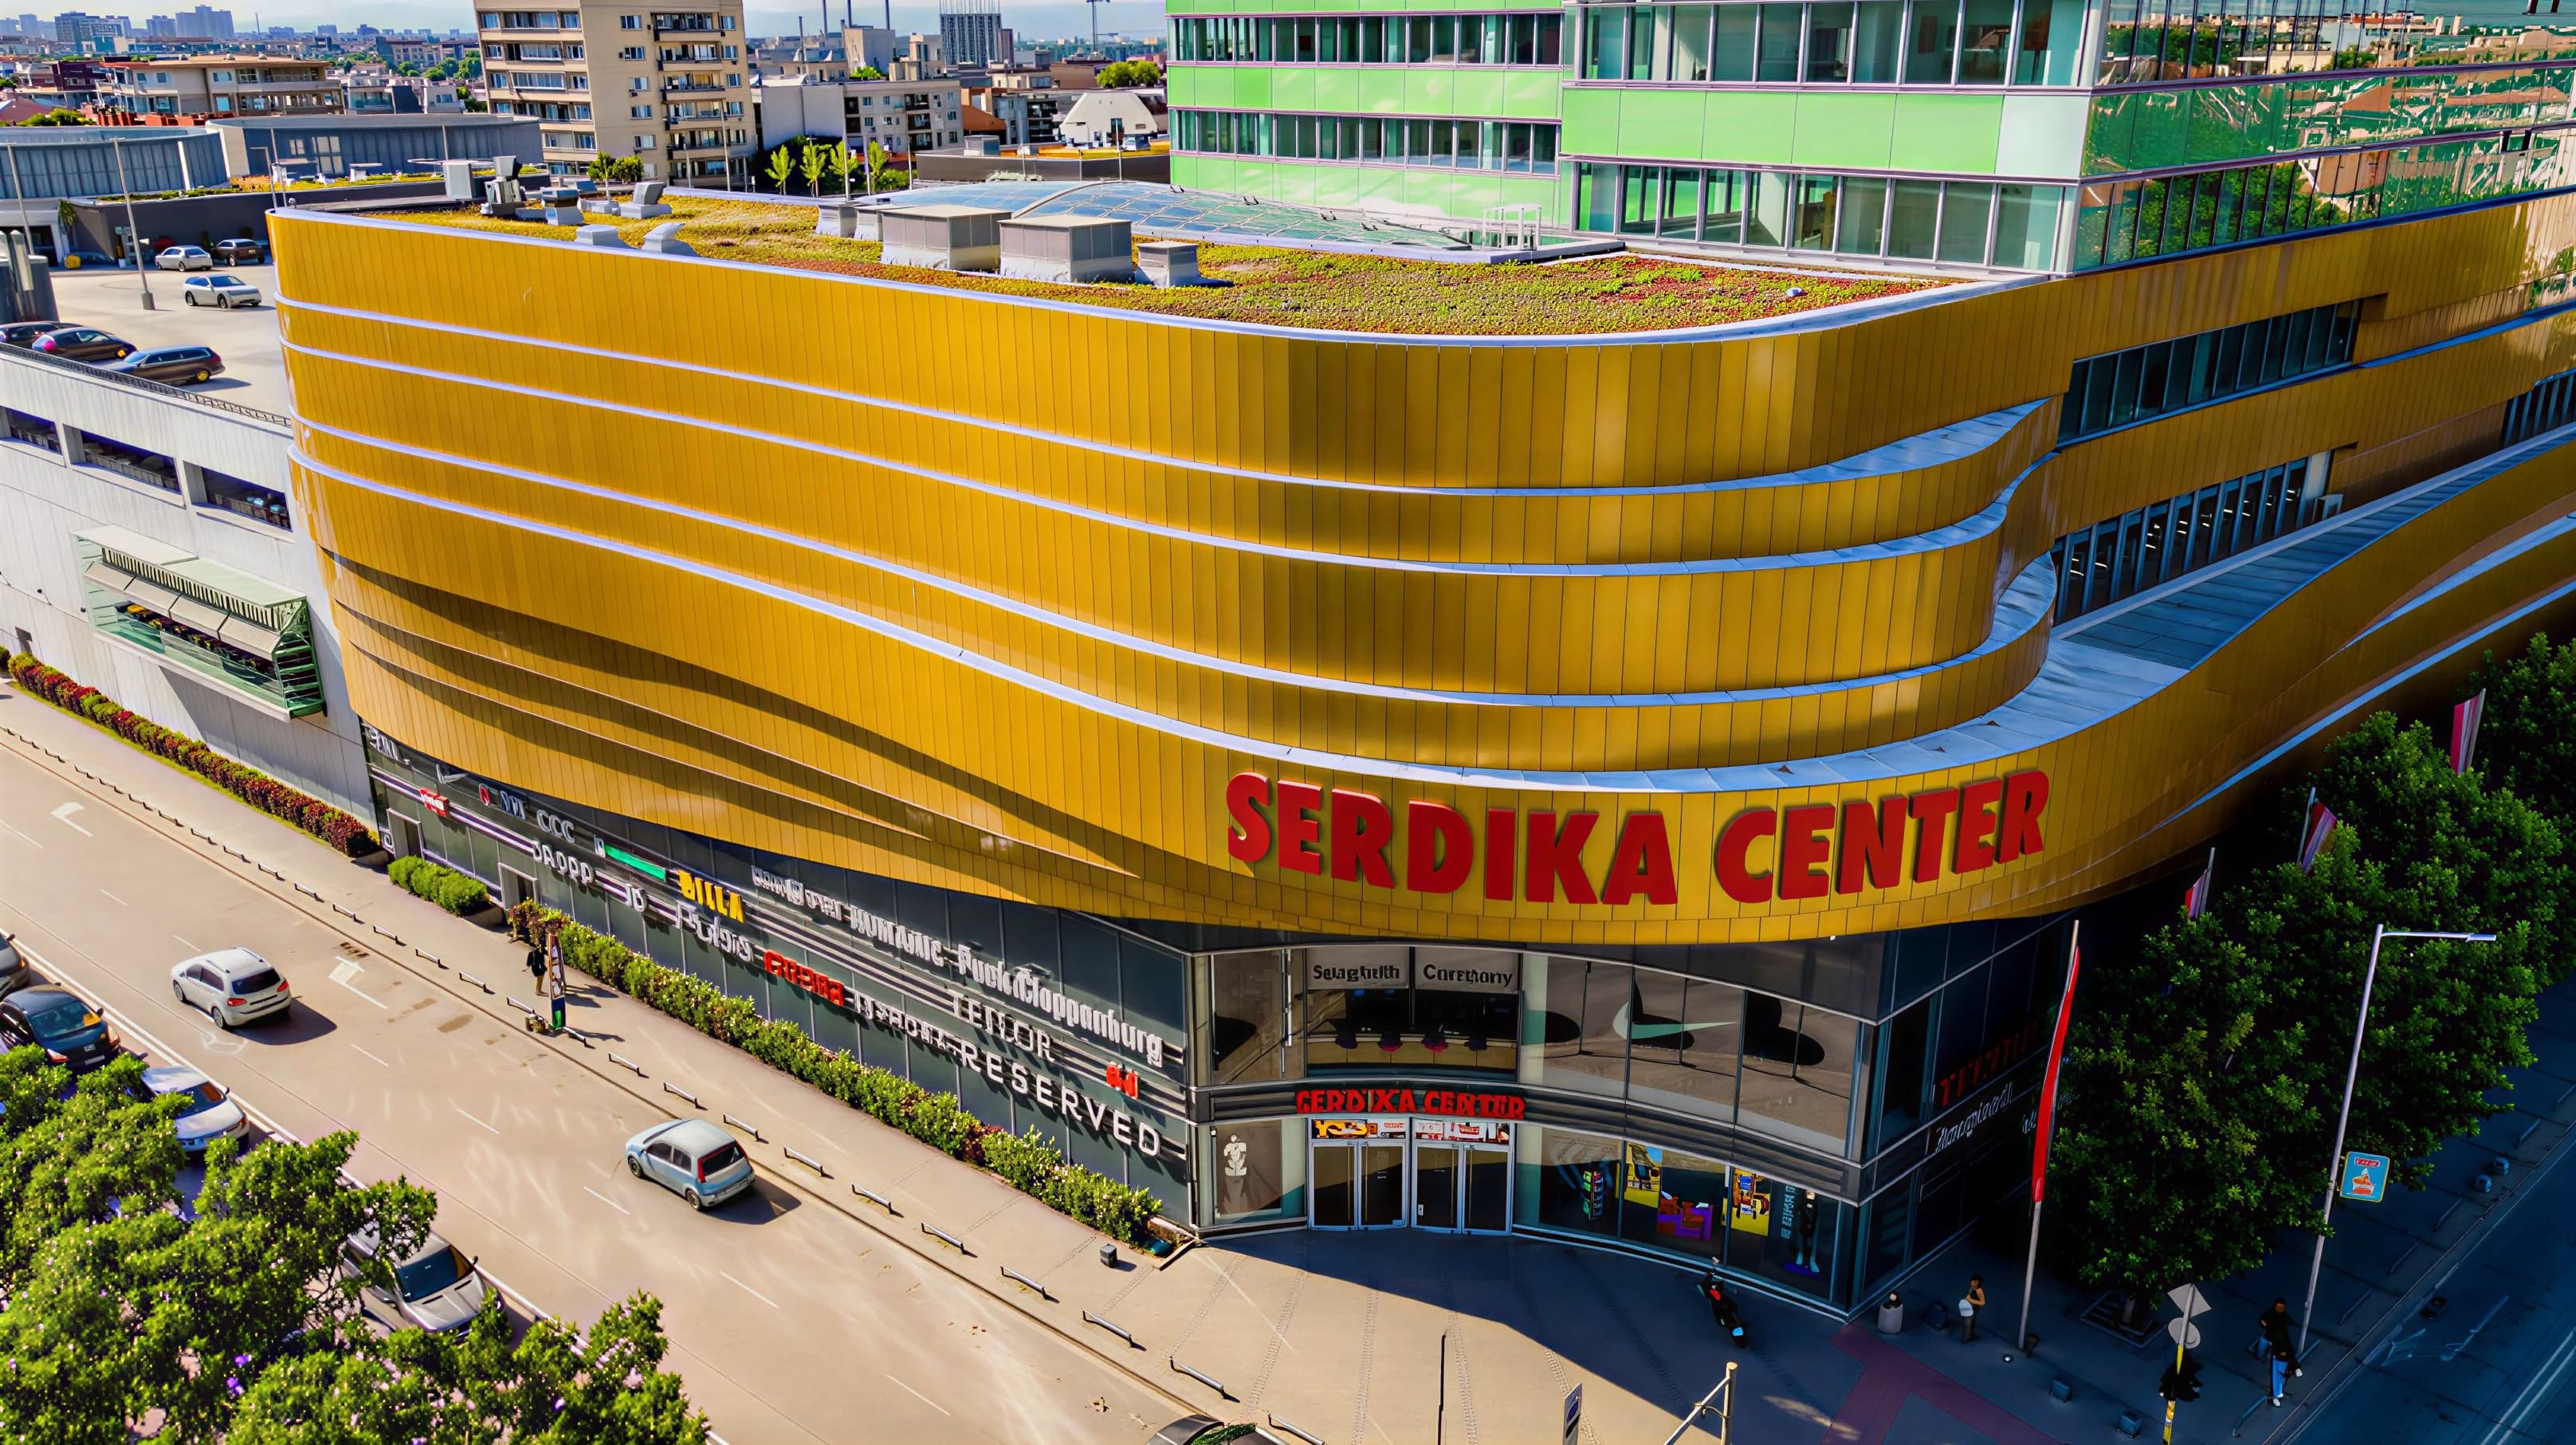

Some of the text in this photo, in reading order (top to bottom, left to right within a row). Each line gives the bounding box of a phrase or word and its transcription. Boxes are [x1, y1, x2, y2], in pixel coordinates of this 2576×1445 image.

[536, 809, 575, 843] CCC
[1227, 769, 2051, 906] SERDIKA CENTER
[677, 870, 746, 924] BILLA
[960, 1039, 1160, 1157] RESERVED
